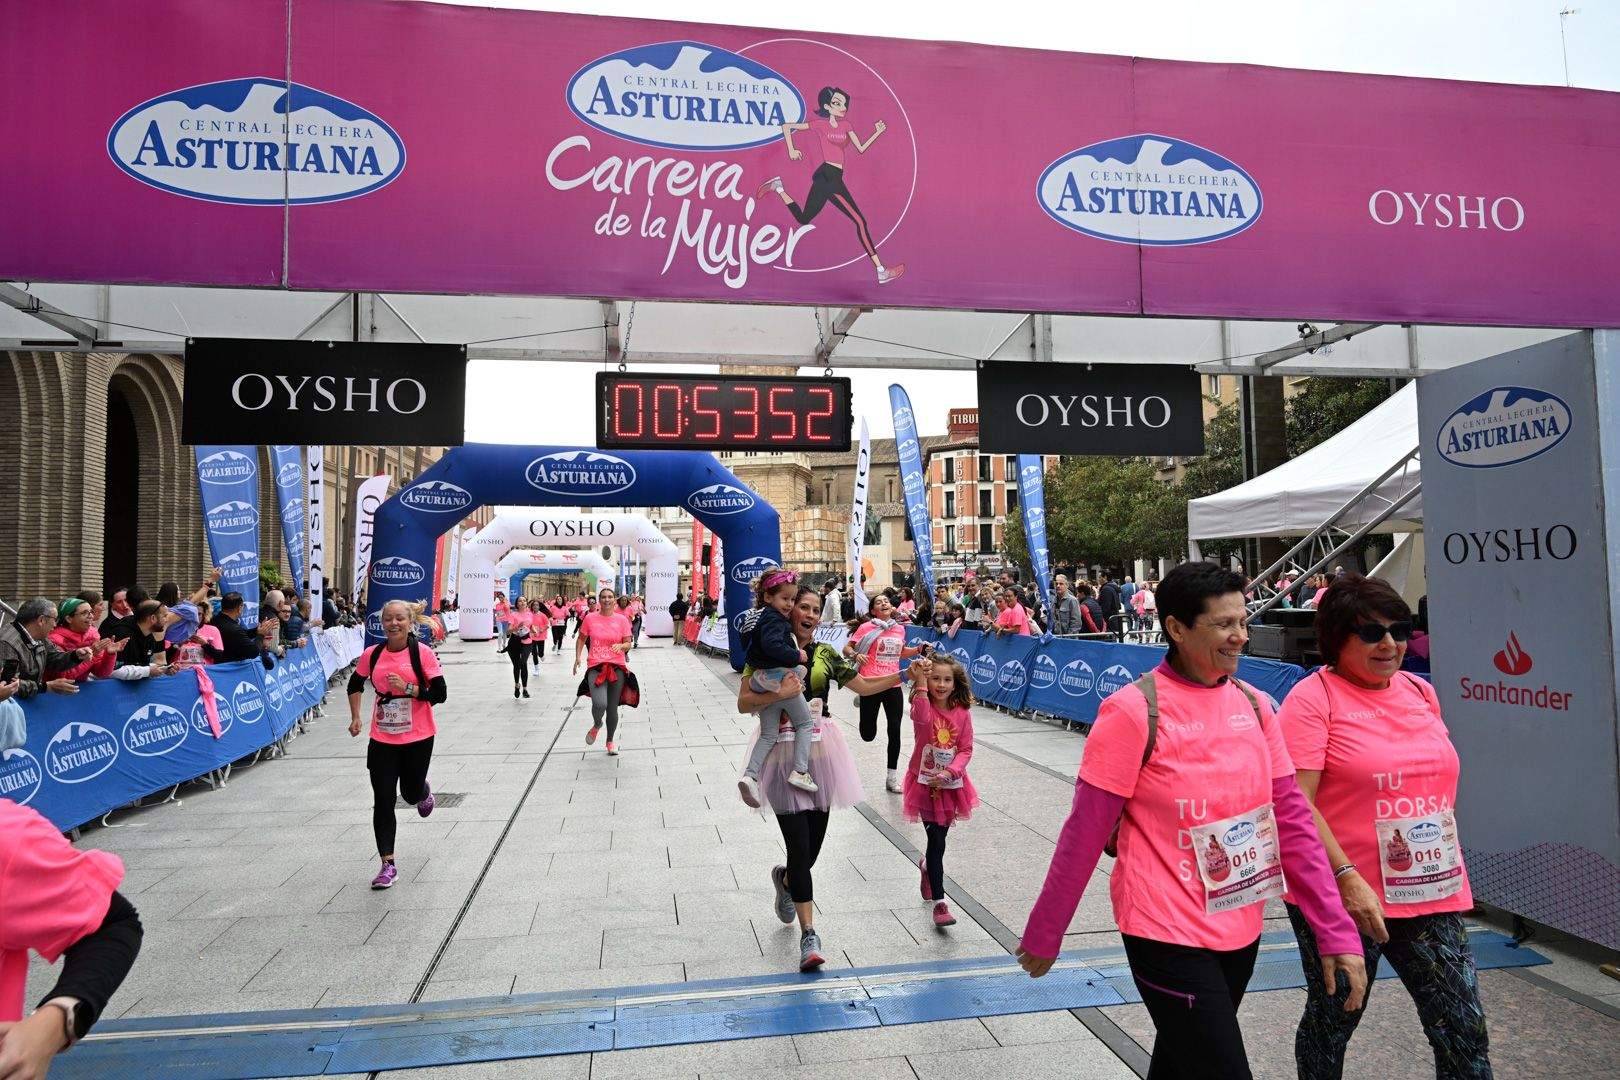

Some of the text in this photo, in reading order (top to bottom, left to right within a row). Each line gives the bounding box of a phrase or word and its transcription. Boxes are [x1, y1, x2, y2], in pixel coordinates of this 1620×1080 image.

[624, 75, 780, 95] CENTRAL LECHERA
[586, 75, 787, 126] ASTURIANA
[180, 119, 375, 139] CENTRAL LECHERA
[131, 119, 384, 177] ASTURIANA
[545, 135, 744, 200] Carrera
[1090, 171, 1239, 187] CENTRAL LECHERA
[1055, 171, 1247, 219] ASTURIANA
[1369, 189, 1525, 231] OYSHO
[594, 197, 816, 290] de la Mujer
[231, 373, 427, 414] OYSHO
[1016, 393, 1171, 429] OYSHO
[1462, 404, 1555, 429] CENTRAL LECHERA
[1445, 415, 1561, 455] ASTURIANA
[533, 463, 628, 485] ASTURIANA
[956, 461, 964, 501] HOTEL
[404, 491, 467, 505] ASTURIANA
[693, 496, 750, 508] ASTURIANA
[529, 520, 615, 536] OYSHO
[1443, 524, 1578, 565] OYSHO
[372, 566, 420, 579] ASTURIANA
[735, 567, 764, 579] ASTUR
[1460, 677, 1573, 711] Santander
[130, 722, 185, 749] ASTURIANA
[52, 741, 115, 775] ASTURIANA
[0, 767, 38, 796] URIANA
[1373, 771, 1402, 791] TU
[1175, 799, 1207, 820] TU
[1376, 795, 1451, 818] DORSA
[1233, 847, 1257, 867] 016
[1415, 848, 1441, 862] 016
[1422, 864, 1440, 873] 3080
[1215, 895, 1243, 908] OYSHO
[1395, 889, 1424, 897] OYSHO
